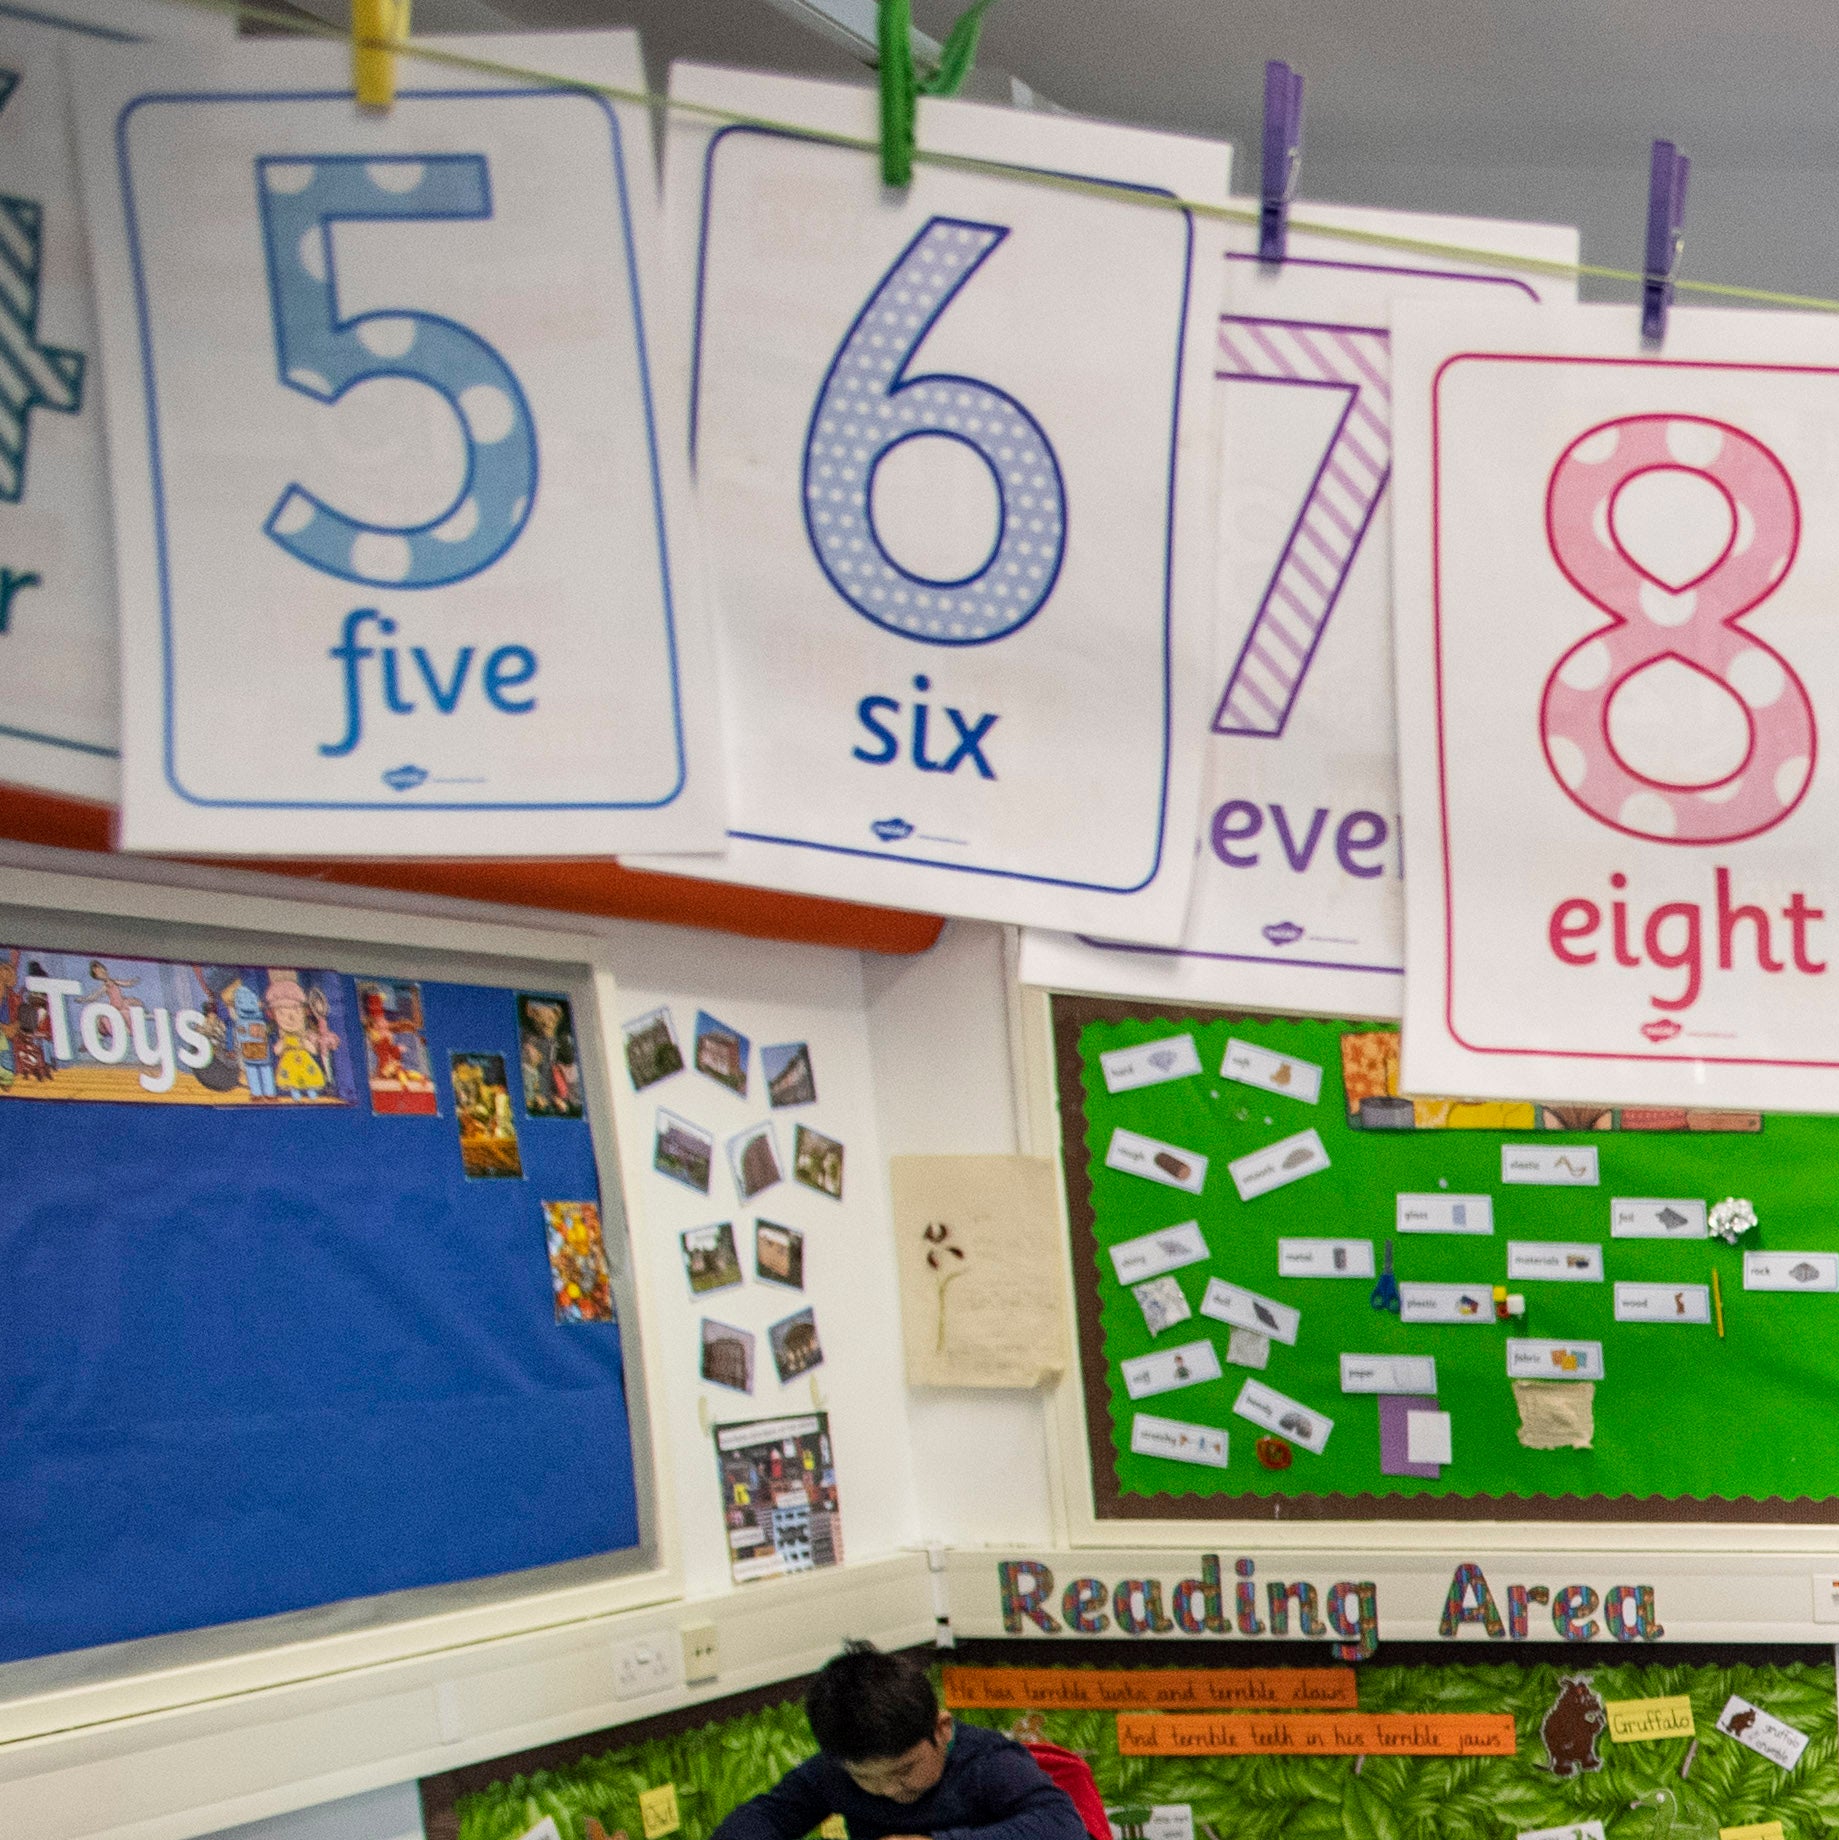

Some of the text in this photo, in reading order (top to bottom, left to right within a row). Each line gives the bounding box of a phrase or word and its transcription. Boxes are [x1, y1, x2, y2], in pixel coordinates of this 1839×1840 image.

[257, 153, 539, 591] 5
[802, 215, 1067, 645] 6
[1212, 315, 1390, 737] 7
[319, 609, 539, 757] five
[1541, 413, 1818, 845] 8
[853, 675, 1000, 779] six
[1205, 800, 1399, 880] eve
[1548, 868, 1828, 1010] eight
[26, 976, 213, 1093] Toys
[998, 1554, 1664, 1660] Reading Area
[1125, 1725, 1158, 1746] And
[1171, 1725, 1237, 1747] terrible
[1250, 1725, 1293, 1746] teeth
[1307, 1731, 1323, 1746] in
[1334, 1725, 1364, 1746] his
[1376, 1725, 1439, 1746] terrible
[1157, 1681, 1197, 1700] and
[1209, 1681, 1275, 1700] terrible
[1614, 1710, 1690, 1735] Gruffalo
